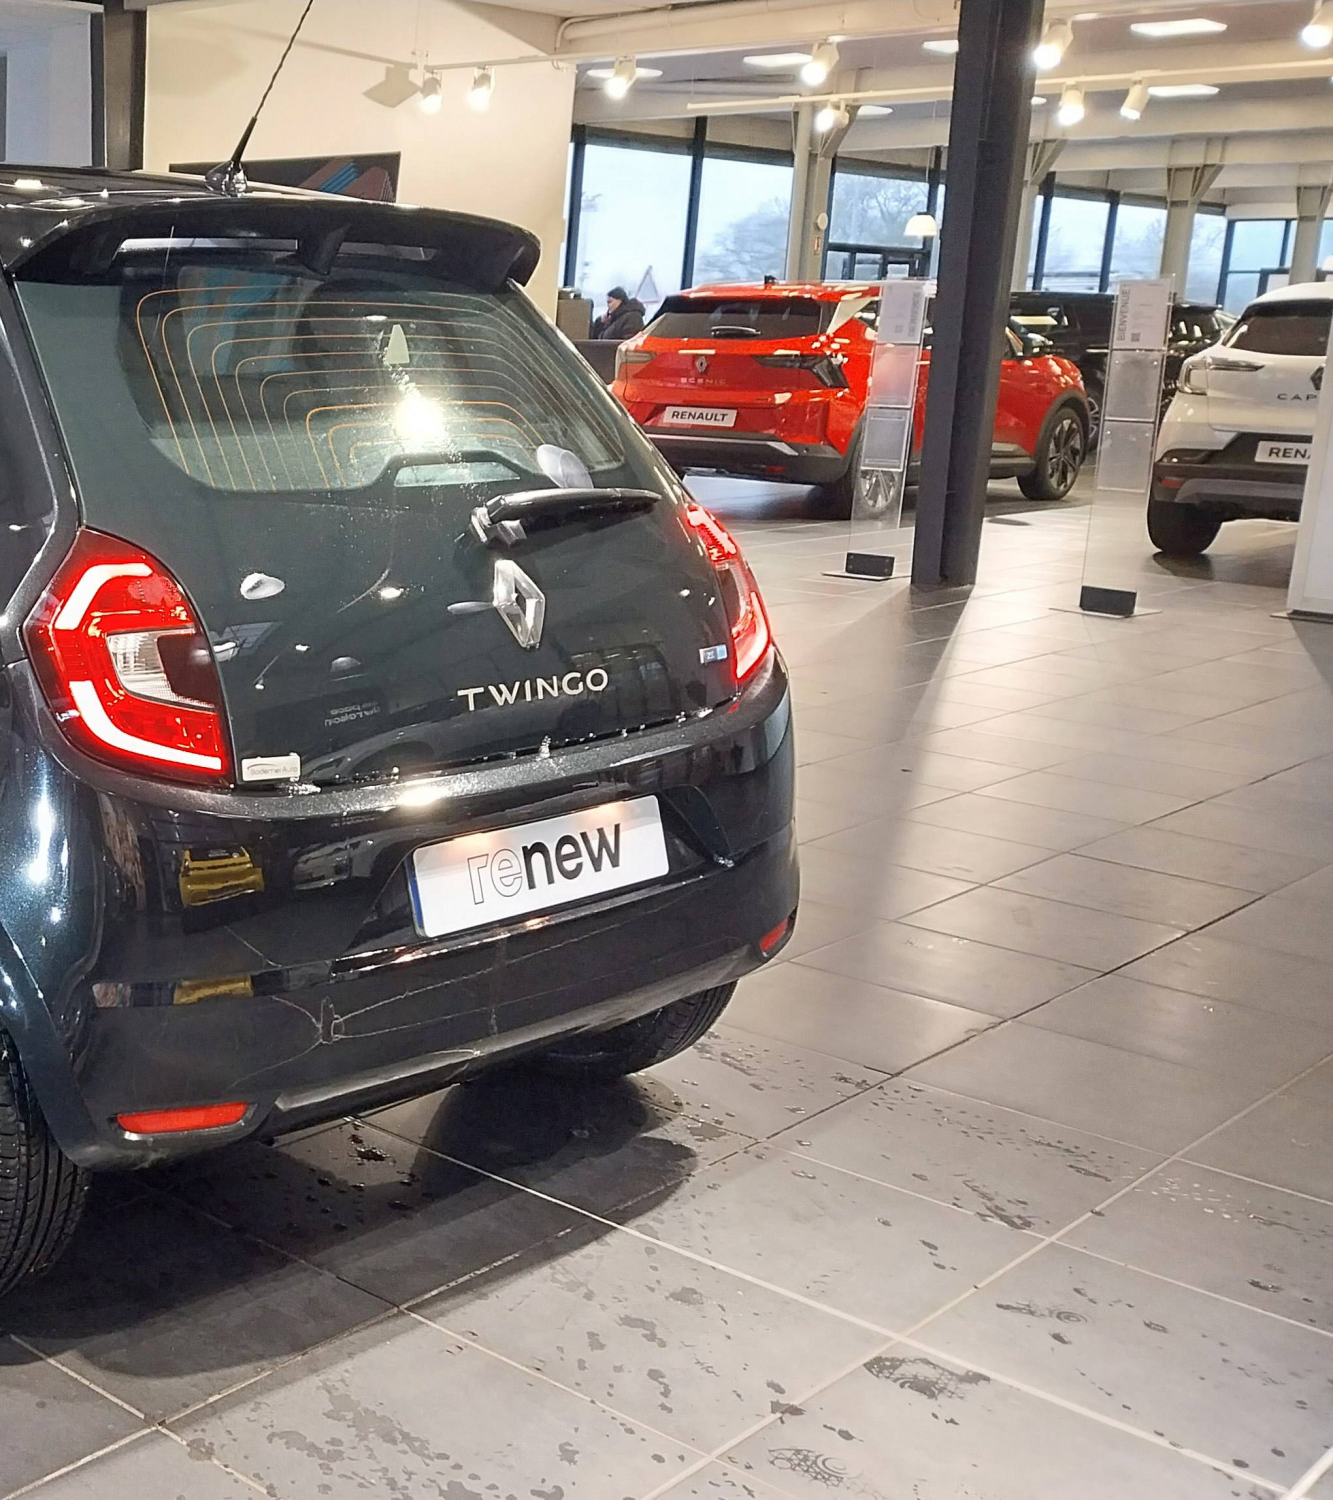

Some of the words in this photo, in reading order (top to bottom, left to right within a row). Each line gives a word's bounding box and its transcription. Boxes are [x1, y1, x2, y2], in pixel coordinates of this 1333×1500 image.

[1116, 289, 1131, 341] BIENVENUE
[680, 377, 727, 385] SCENIC
[671, 410, 729, 422] RENAULT
[456, 667, 610, 712] TWINGO
[467, 822, 622, 906] renew
